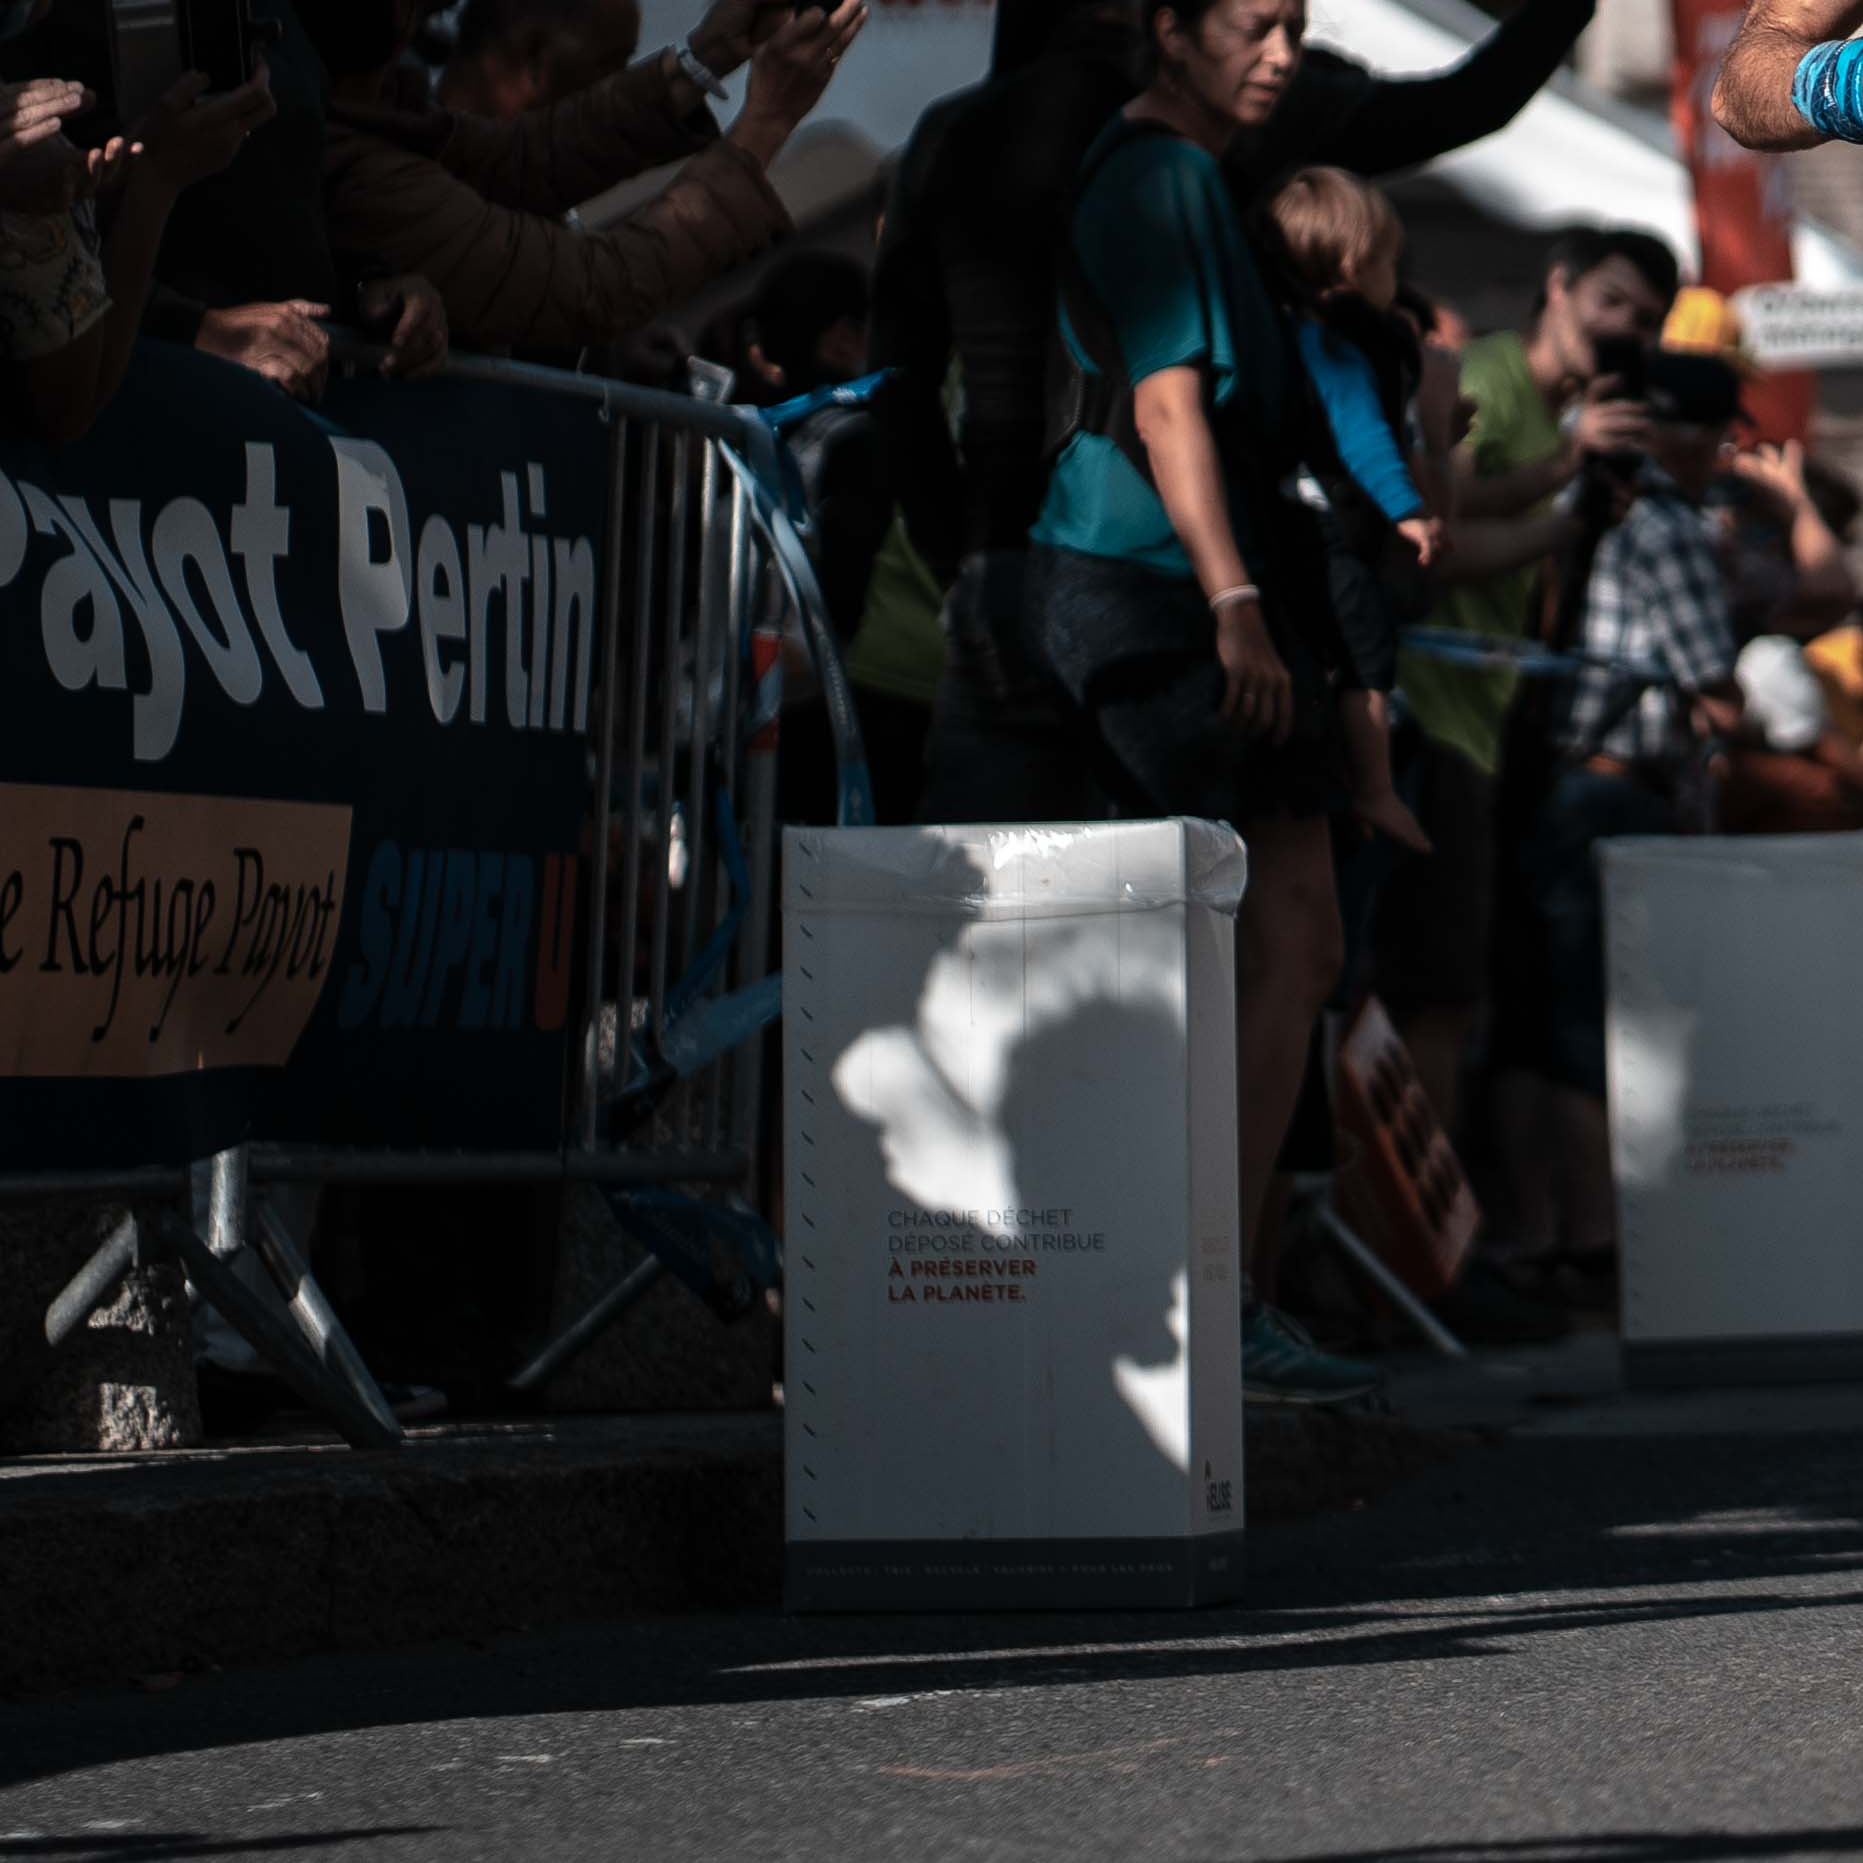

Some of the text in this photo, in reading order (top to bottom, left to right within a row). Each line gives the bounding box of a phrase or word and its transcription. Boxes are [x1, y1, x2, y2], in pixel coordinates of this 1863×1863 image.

[329, 435, 597, 733] Pertin
[39, 815, 217, 1044] Refuge
[213, 846, 338, 1035] Payot
[339, 840, 579, 1032] SUPER U
[887, 1205, 1073, 1227] CHAQUE DÉCHET
[888, 1231, 1106, 1253] DÉPOSÉ CONTRIBUE
[888, 1256, 1038, 1278] À PRÉSERVER
[888, 1280, 1026, 1302] LA PLANÈTE.
